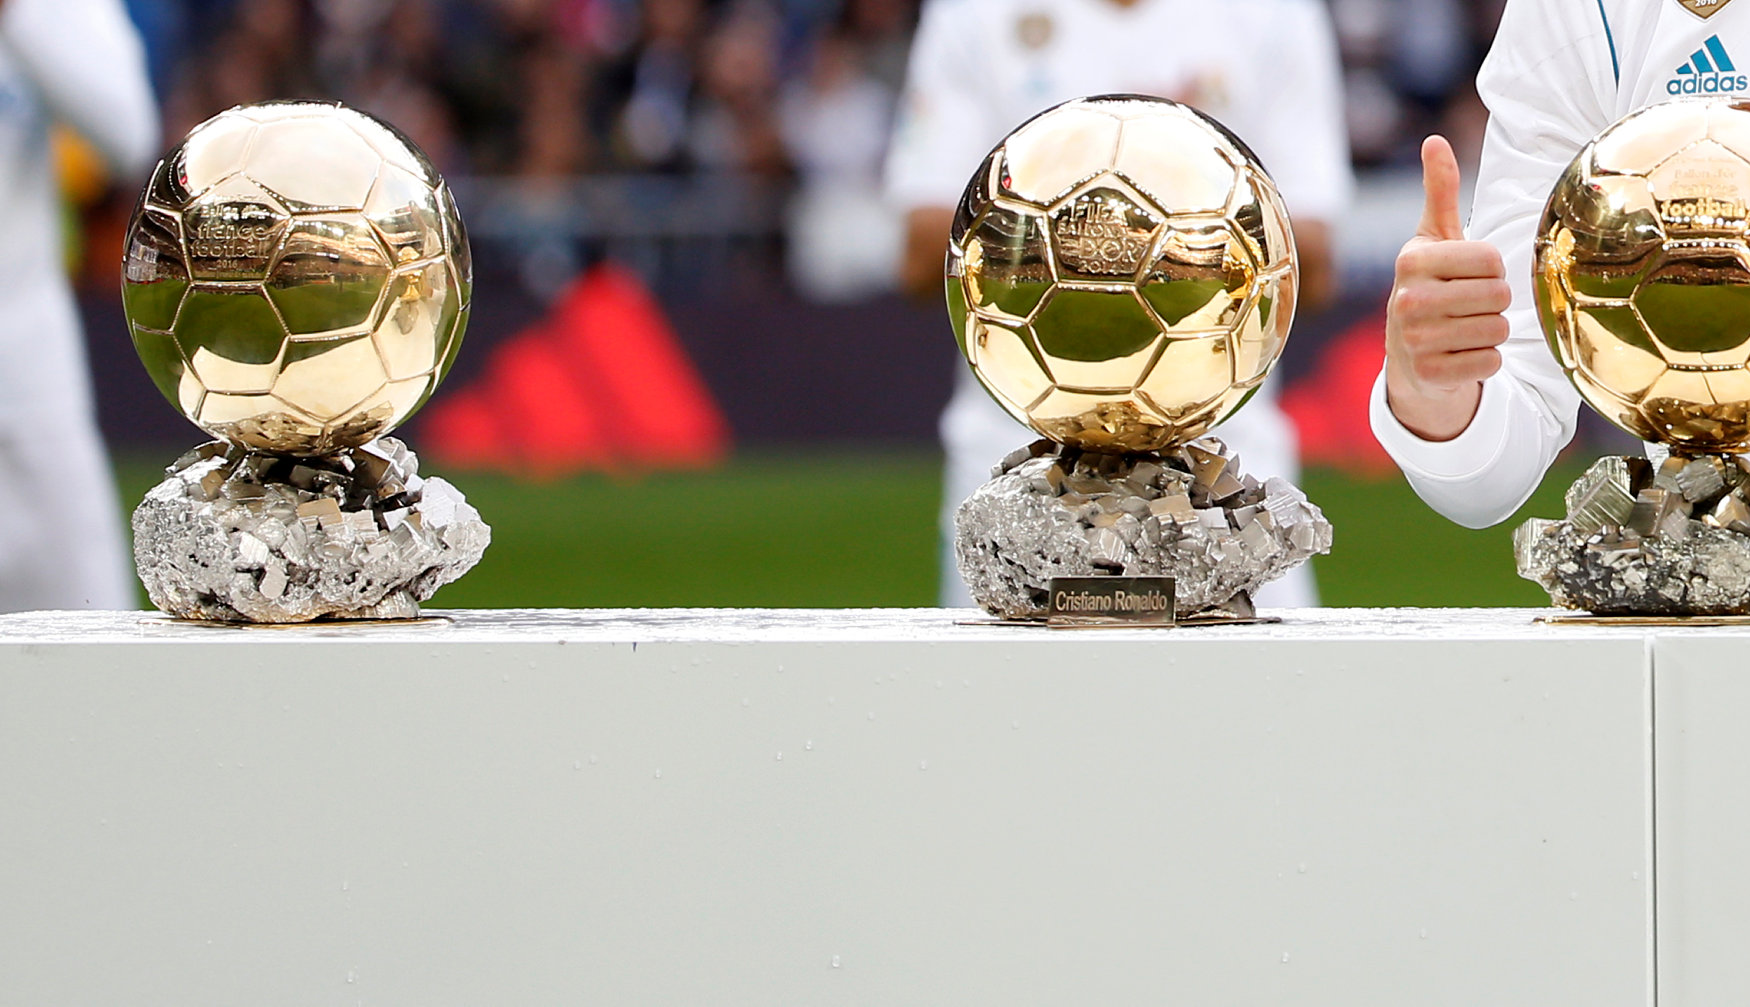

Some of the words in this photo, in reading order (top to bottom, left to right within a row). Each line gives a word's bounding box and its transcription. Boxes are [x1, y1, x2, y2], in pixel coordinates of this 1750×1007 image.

[1666, 72, 1748, 95] adidas
[1660, 197, 1746, 218] football
[189, 239, 270, 259] football
[1055, 590, 1111, 611] Cristiano
[1115, 590, 1168, 611] Ronaldo
